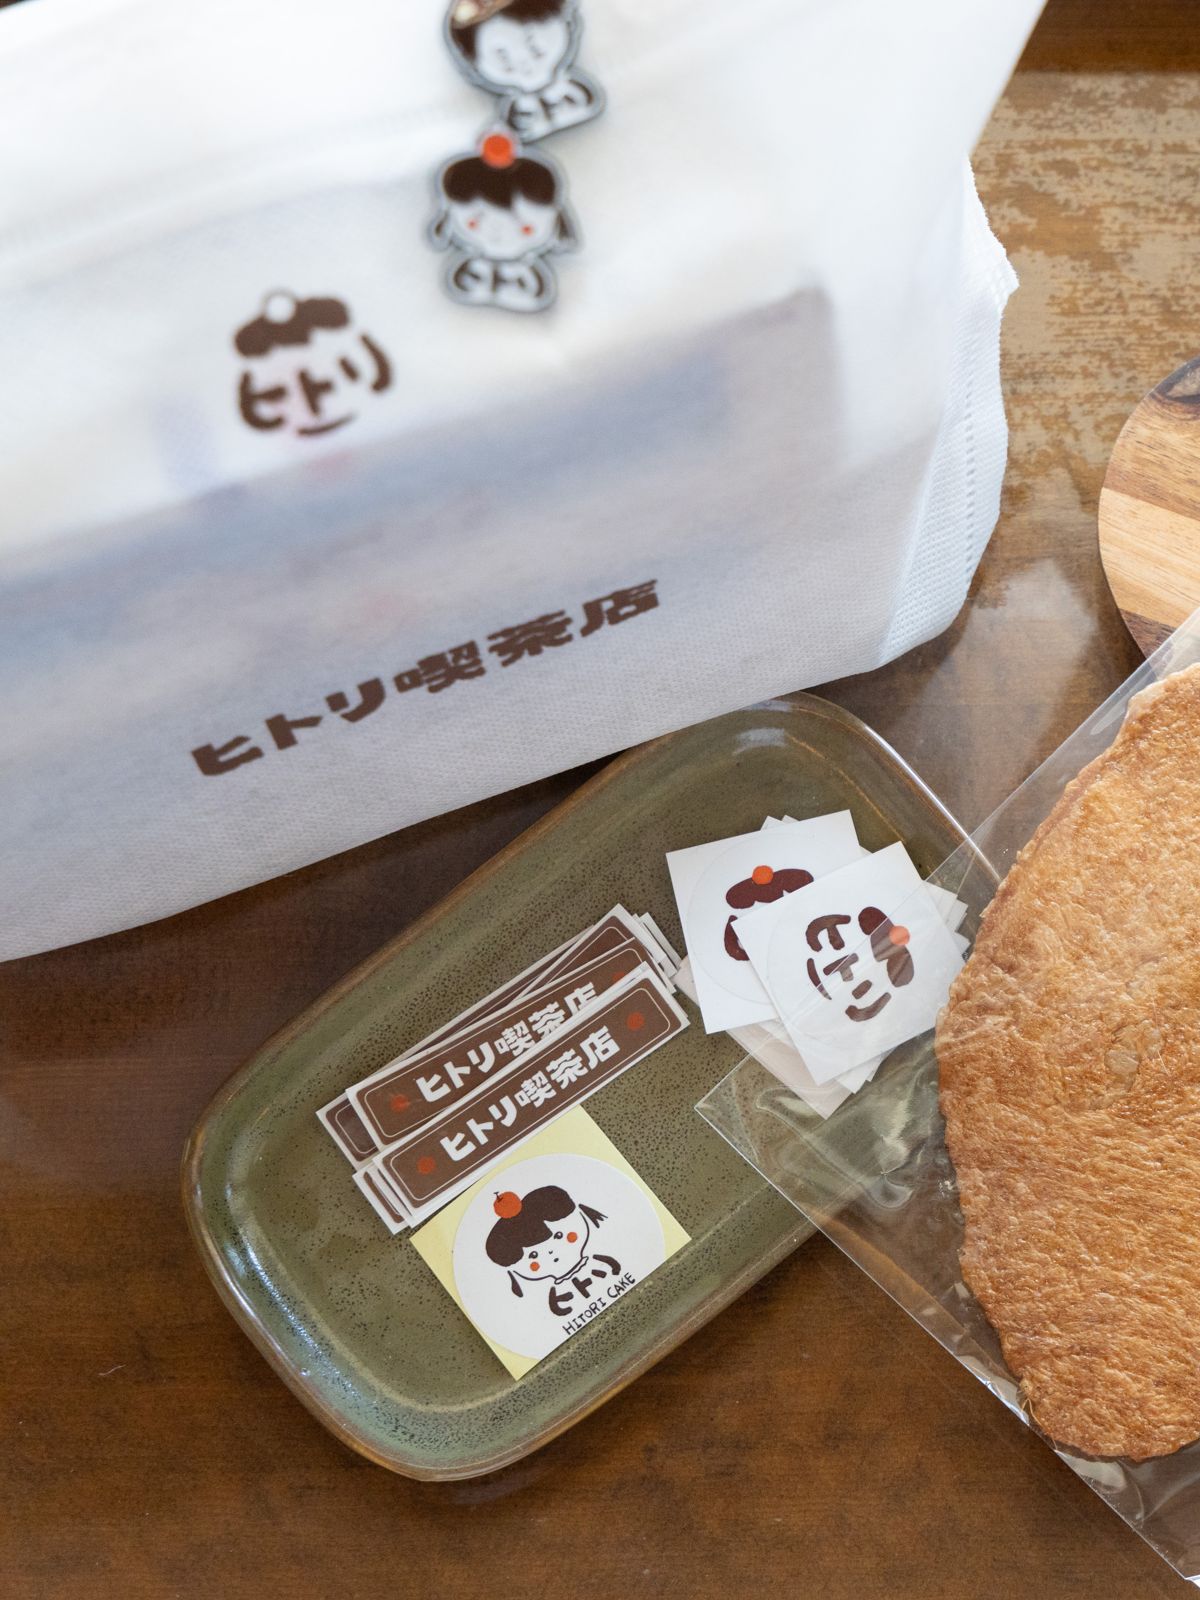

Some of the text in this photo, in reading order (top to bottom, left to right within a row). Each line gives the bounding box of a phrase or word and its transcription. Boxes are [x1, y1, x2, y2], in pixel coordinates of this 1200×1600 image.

[237, 333, 395, 432] ヒトリ
[191, 579, 661, 777] ヒトリ喫茶店
[439, 1026, 620, 1162] ヒトリ喫茶店
[548, 1254, 622, 1317] ヒトリ
[562, 1272, 636, 1335] HITORI CAKE
